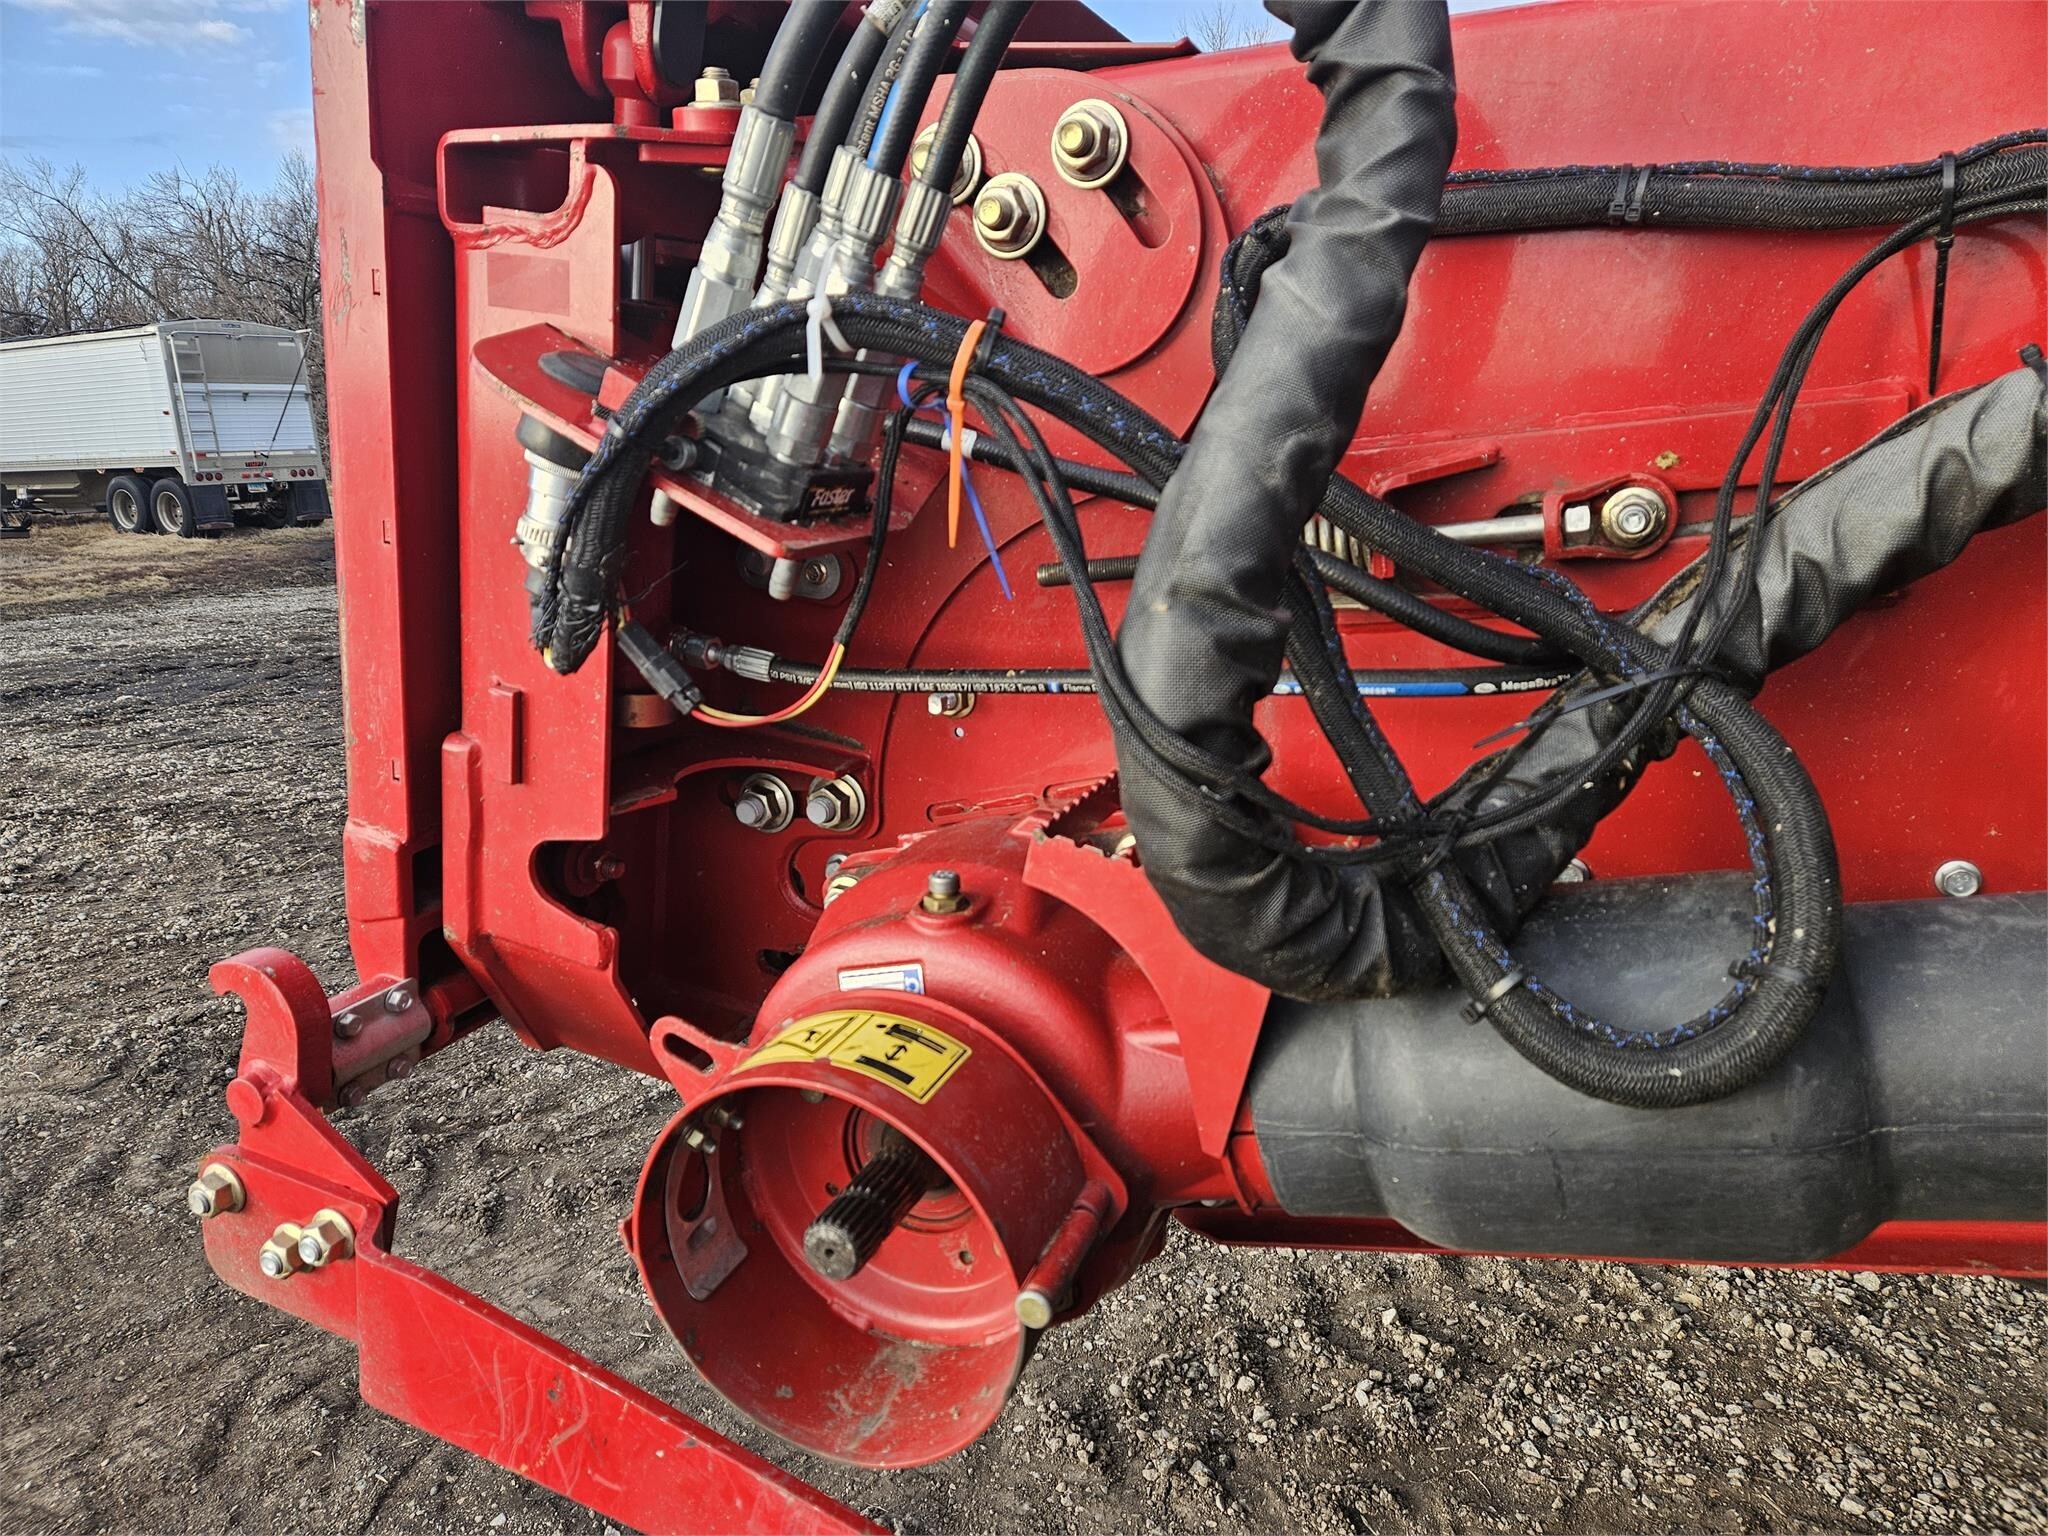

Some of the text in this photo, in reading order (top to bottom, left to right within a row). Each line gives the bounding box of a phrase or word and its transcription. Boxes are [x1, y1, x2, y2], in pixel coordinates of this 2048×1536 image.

[868, 80, 891, 122] MSHA
[811, 487, 855, 508] Faster
[919, 682, 934, 692] SAE
[1016, 682, 1037, 693] Type
[1062, 683, 1090, 693] Flame
